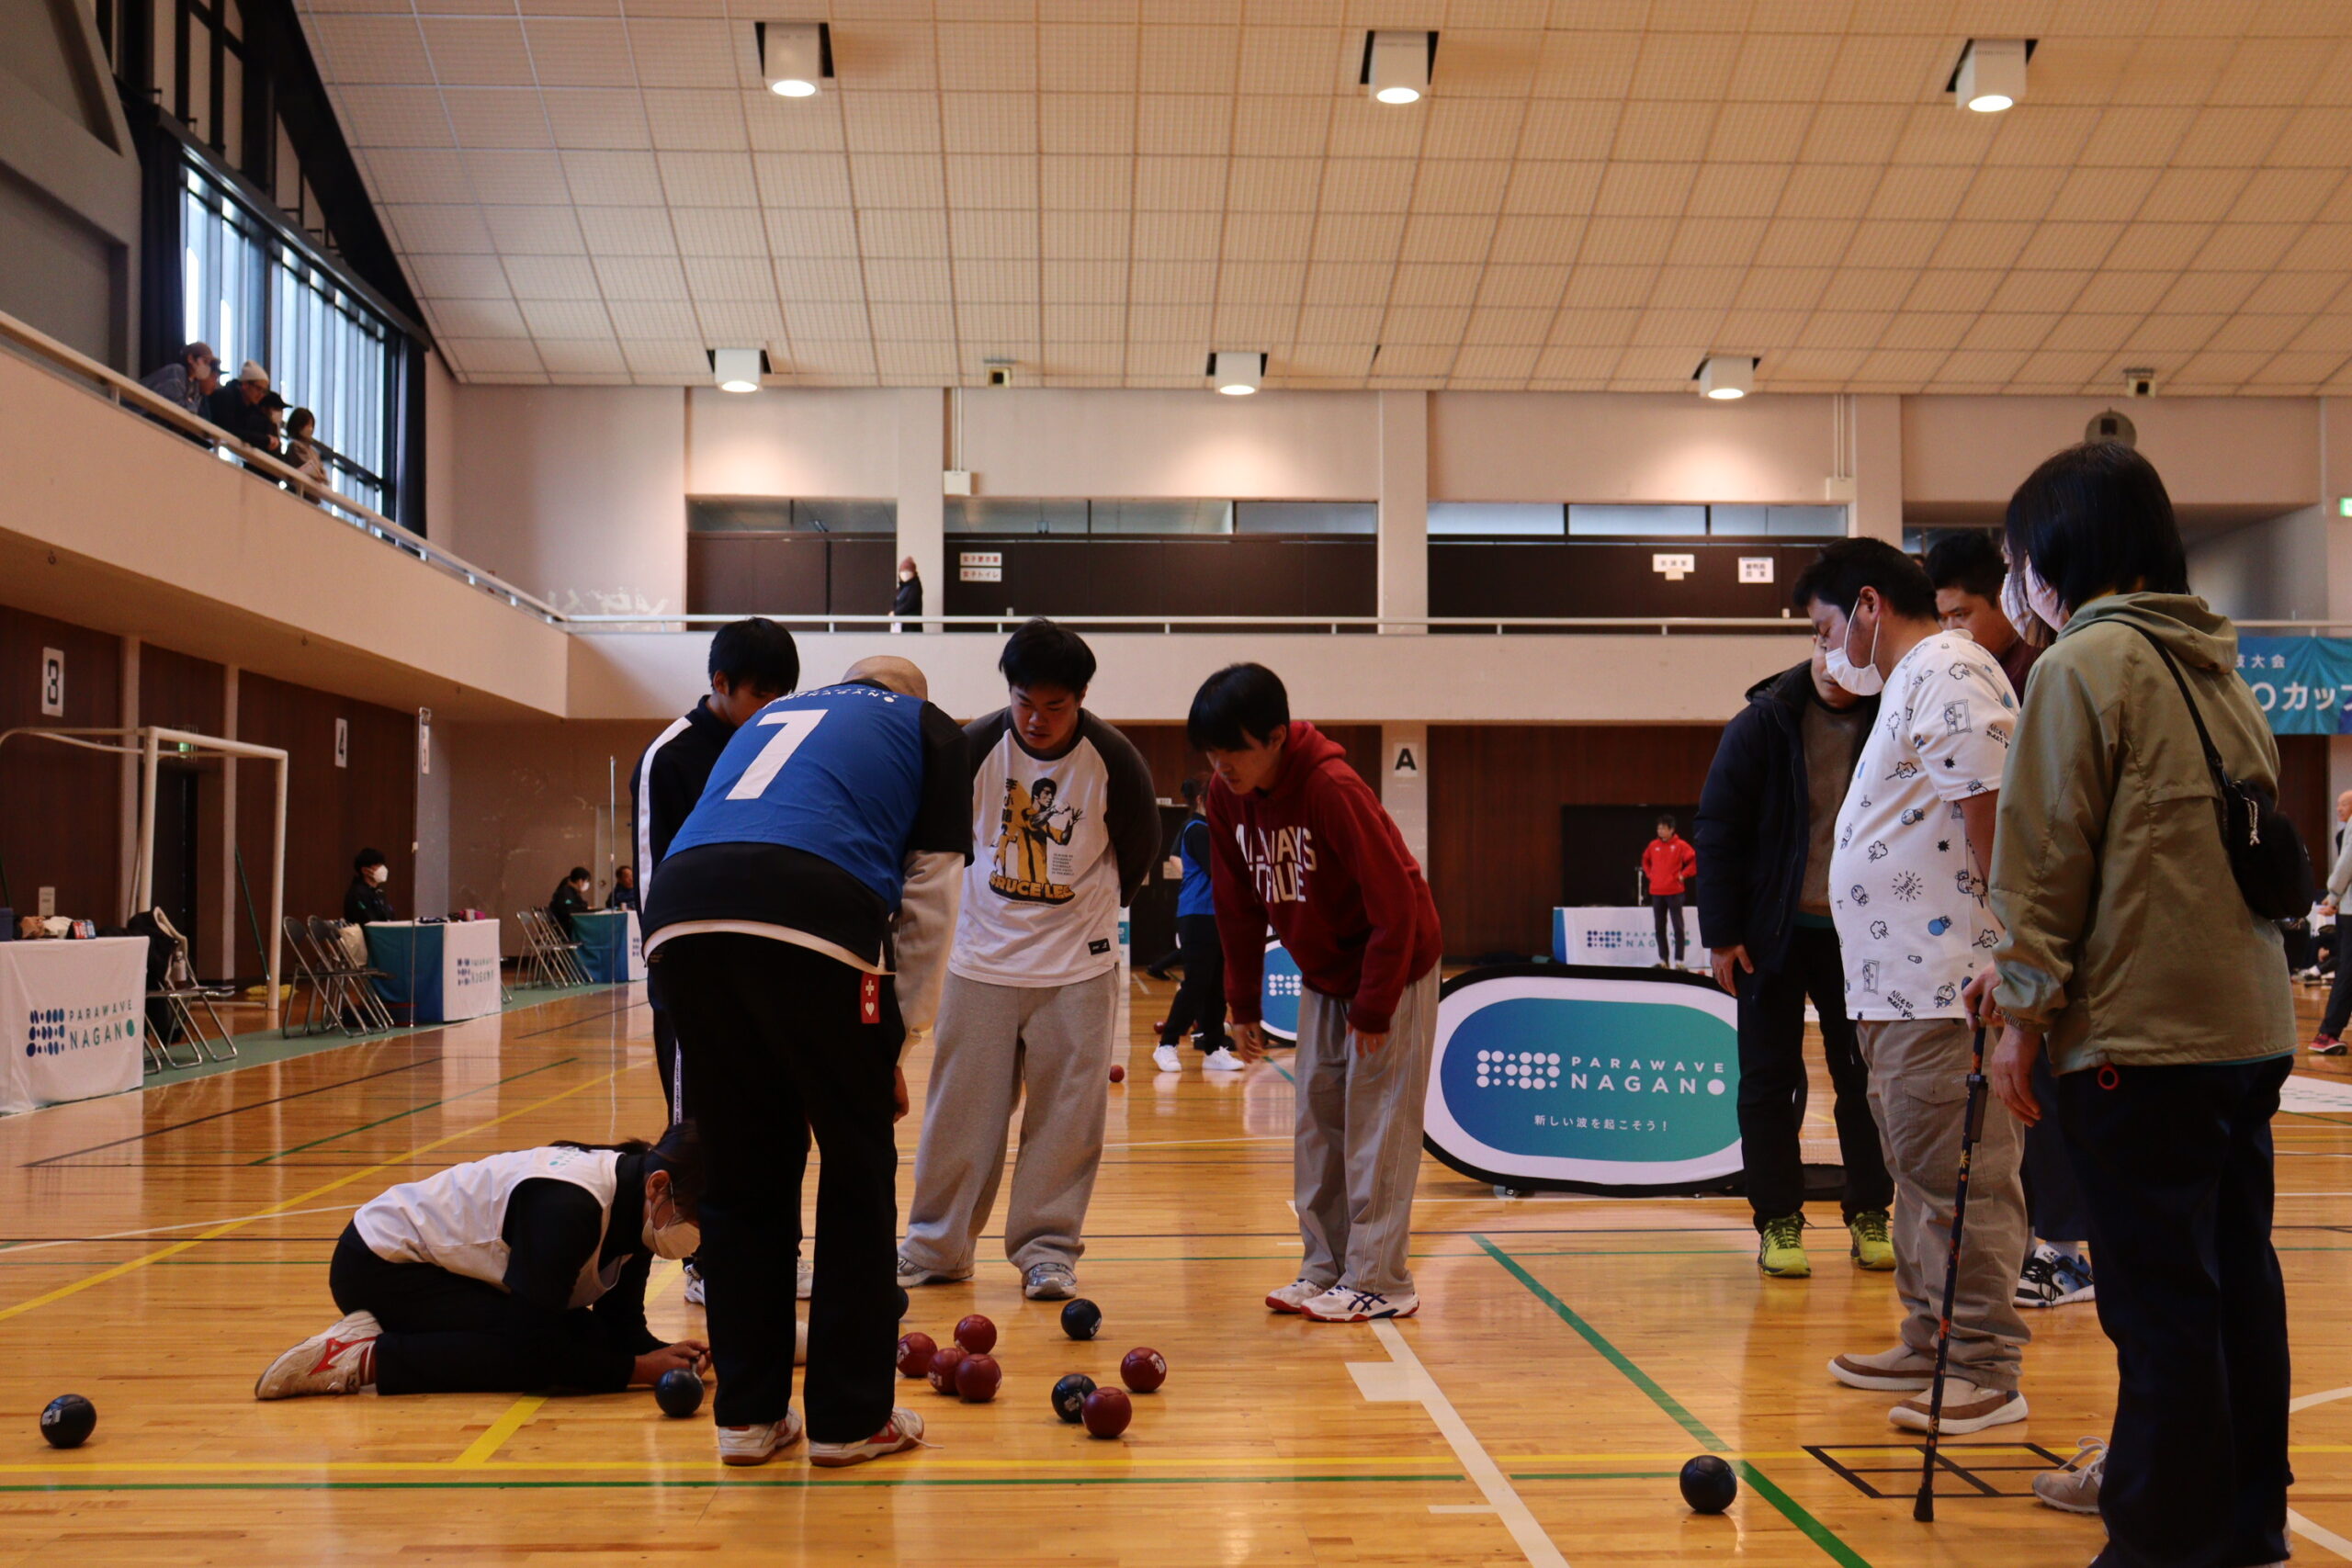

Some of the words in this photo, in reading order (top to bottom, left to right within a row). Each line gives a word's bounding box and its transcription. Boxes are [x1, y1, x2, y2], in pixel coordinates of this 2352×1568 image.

[48, 658, 59, 705] 3
[338, 726, 345, 760] 4
[726, 709, 829, 800] 7
[1395, 748, 1417, 771] A
[69, 999, 132, 1021] PARAWAVE
[1571, 1056, 1724, 1074] PARAWAVE
[1534, 1114, 1668, 1131] 新しい波を起こそう！
